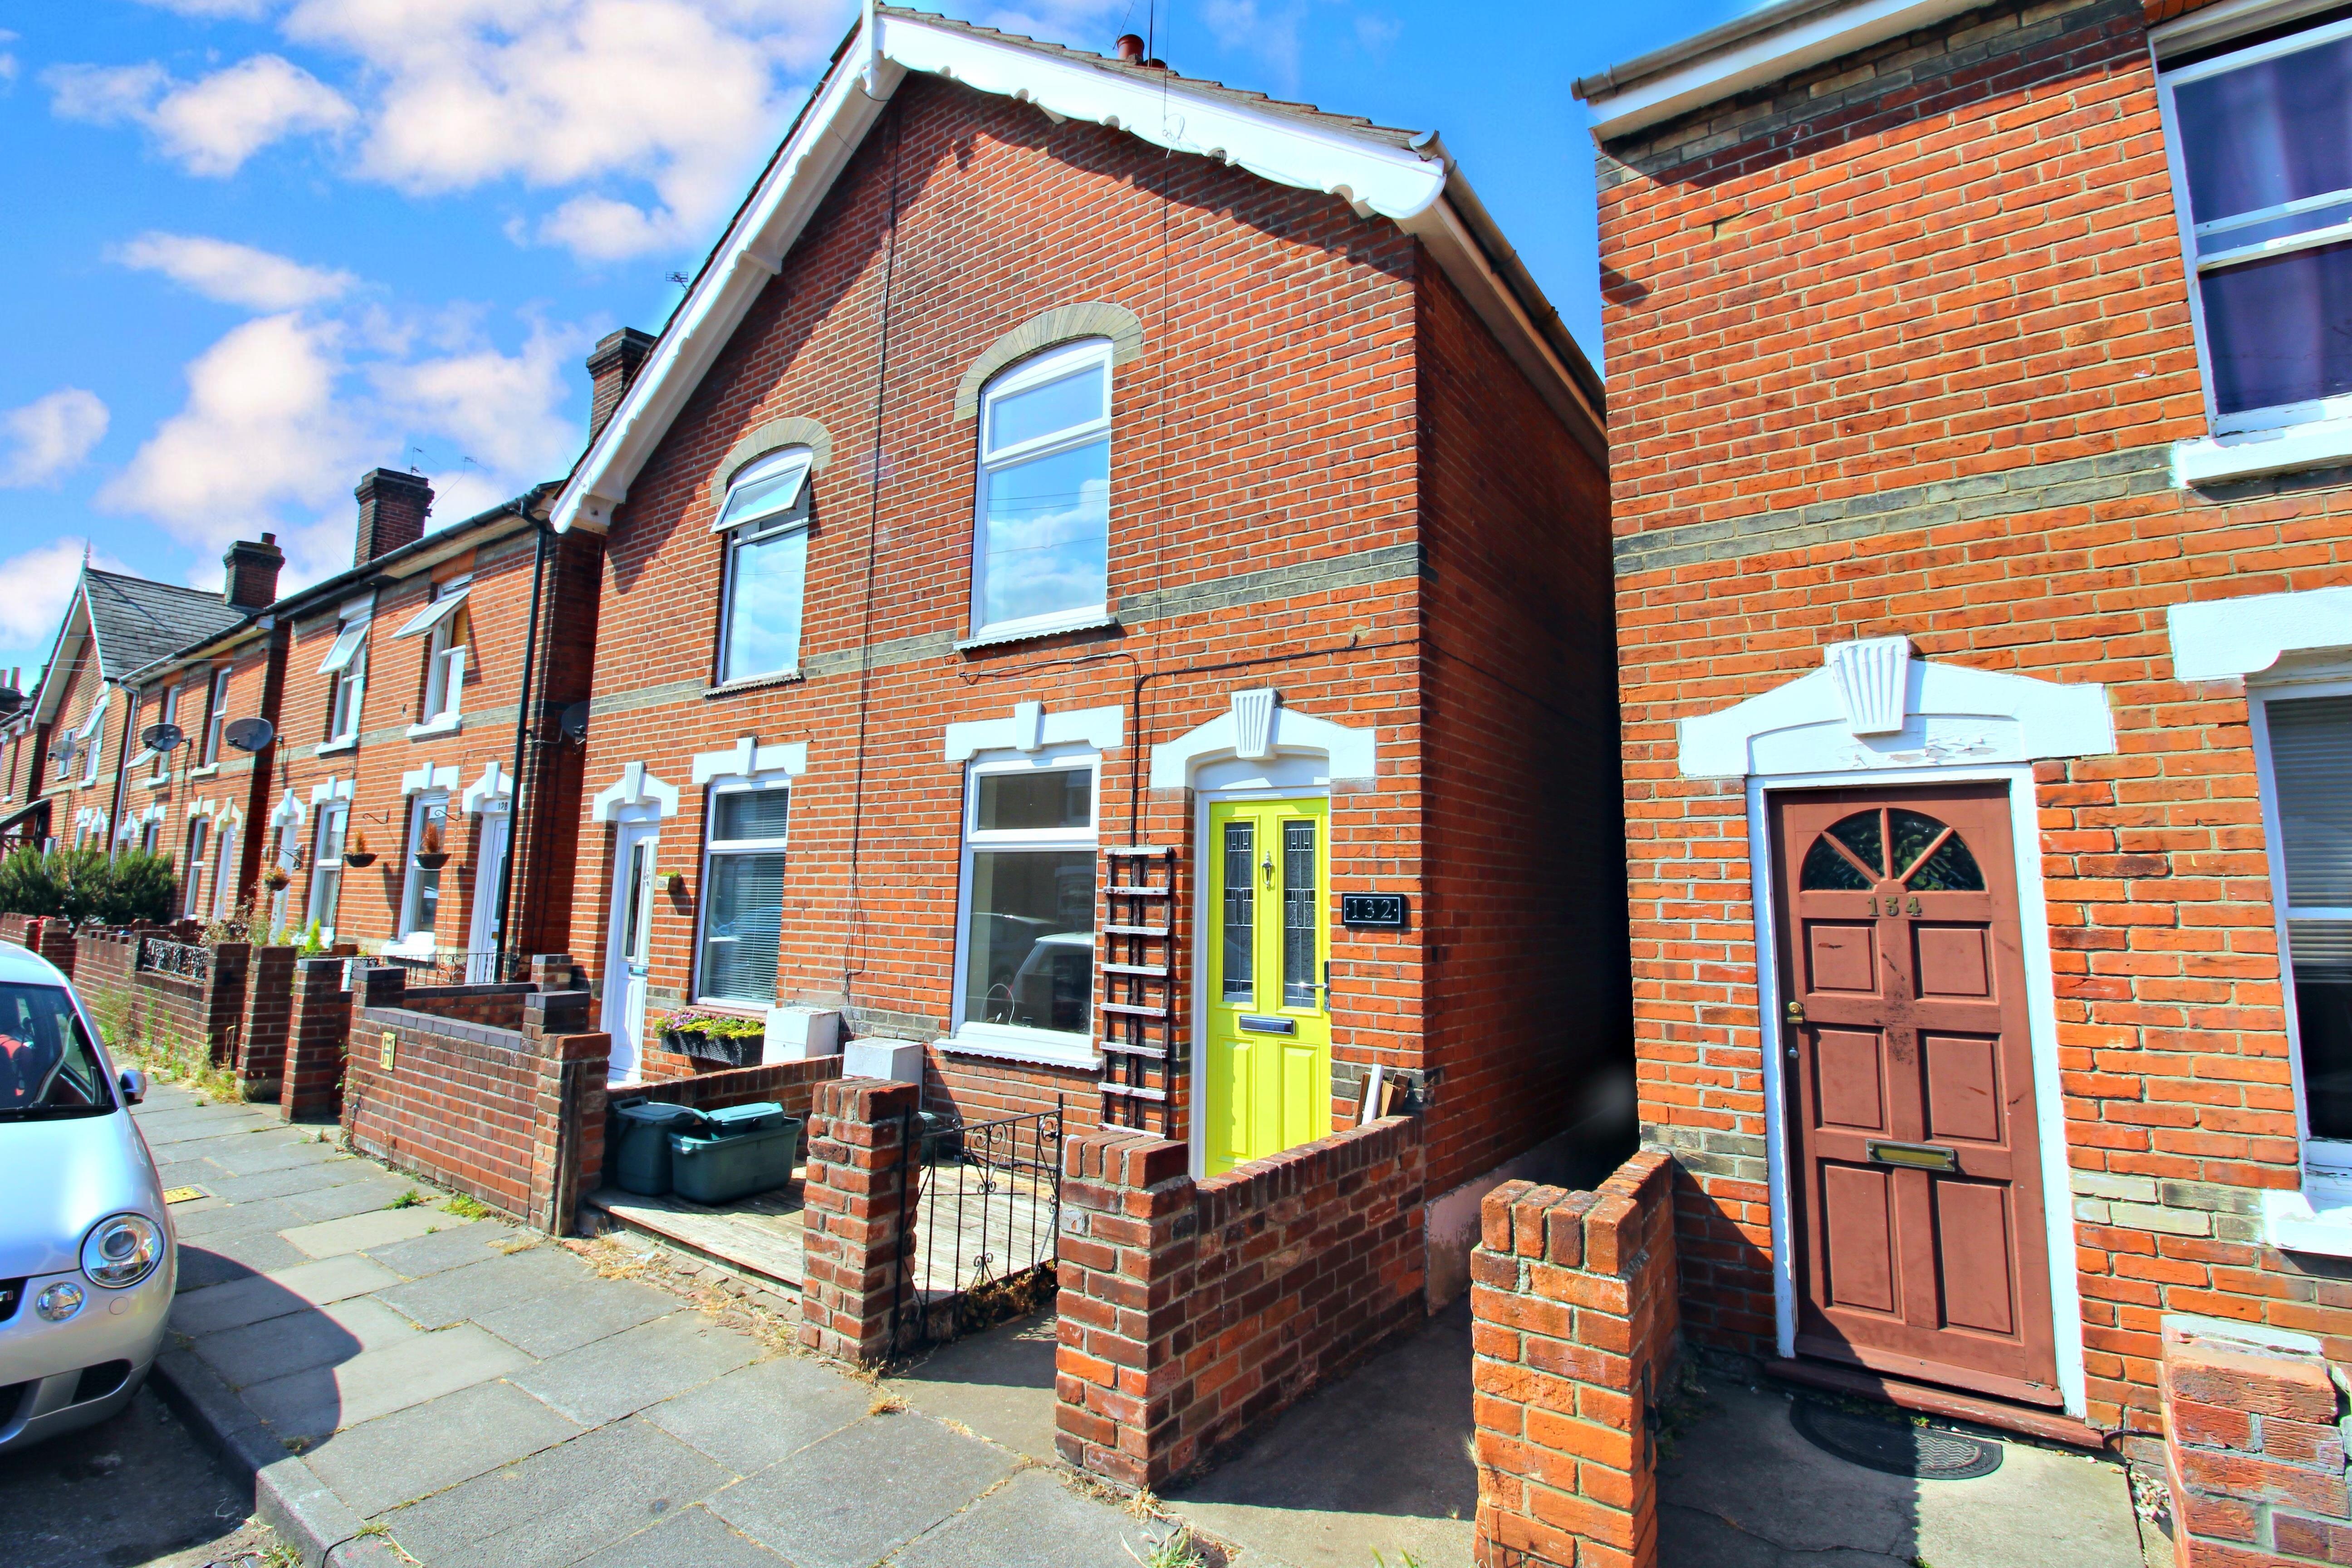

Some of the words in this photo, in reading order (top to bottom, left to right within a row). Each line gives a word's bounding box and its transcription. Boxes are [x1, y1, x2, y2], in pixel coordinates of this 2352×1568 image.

[499, 802, 508, 810] 128
[1352, 899, 1392, 919] 132
[1867, 897, 1922, 916] 134
